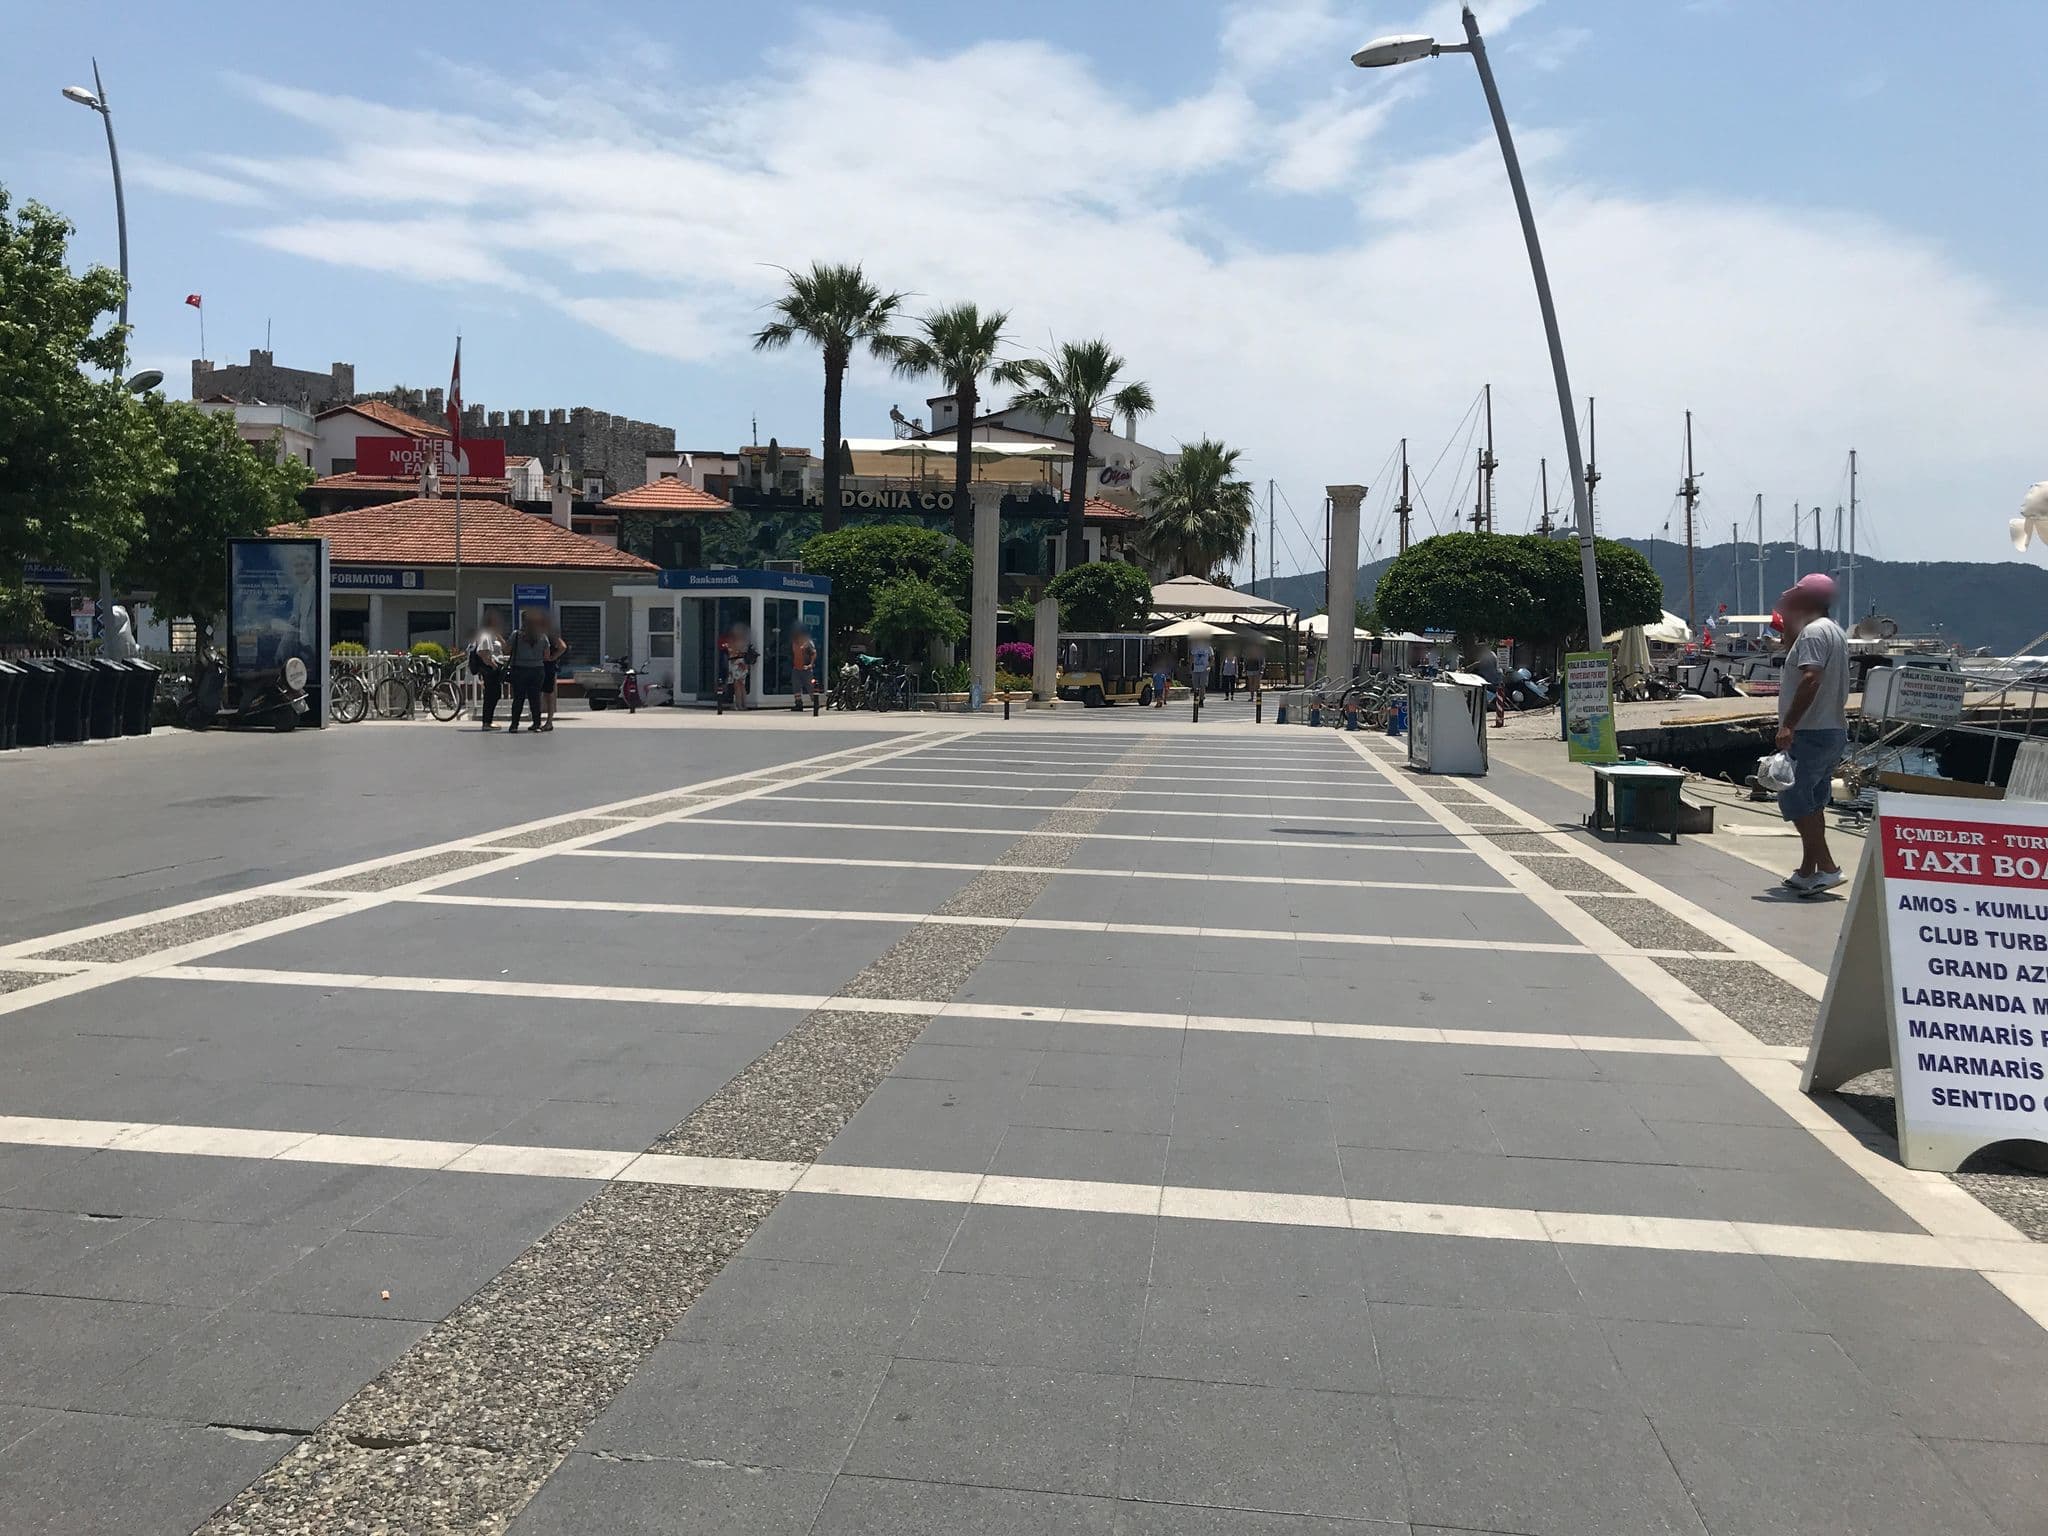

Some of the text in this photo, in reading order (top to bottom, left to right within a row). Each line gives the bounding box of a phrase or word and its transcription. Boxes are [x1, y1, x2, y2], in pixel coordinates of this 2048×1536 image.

[412, 438, 443, 452] THE
[331, 572, 393, 584] FORMATION
[689, 574, 740, 585] Bankamatik
[782, 576, 815, 589] Bankamatik
[1904, 681, 1923, 690] PRIVATE
[1894, 824, 1986, 846] İÇMELER
[2003, 834, 2048, 850] TUR
[1897, 847, 1982, 876] TAXI
[1898, 894, 1958, 914] AMOS
[1975, 900, 2048, 921] KUMLU
[1919, 925, 2048, 951] CLUB TURB
[1928, 957, 2048, 983] GRAND AZ
[1901, 986, 2027, 1014] LABRANDA
[1908, 1019, 2034, 1047] MARMARİS
[1917, 1053, 2045, 1081] MARMARİS
[1931, 1087, 2037, 1113] SENTIDO
